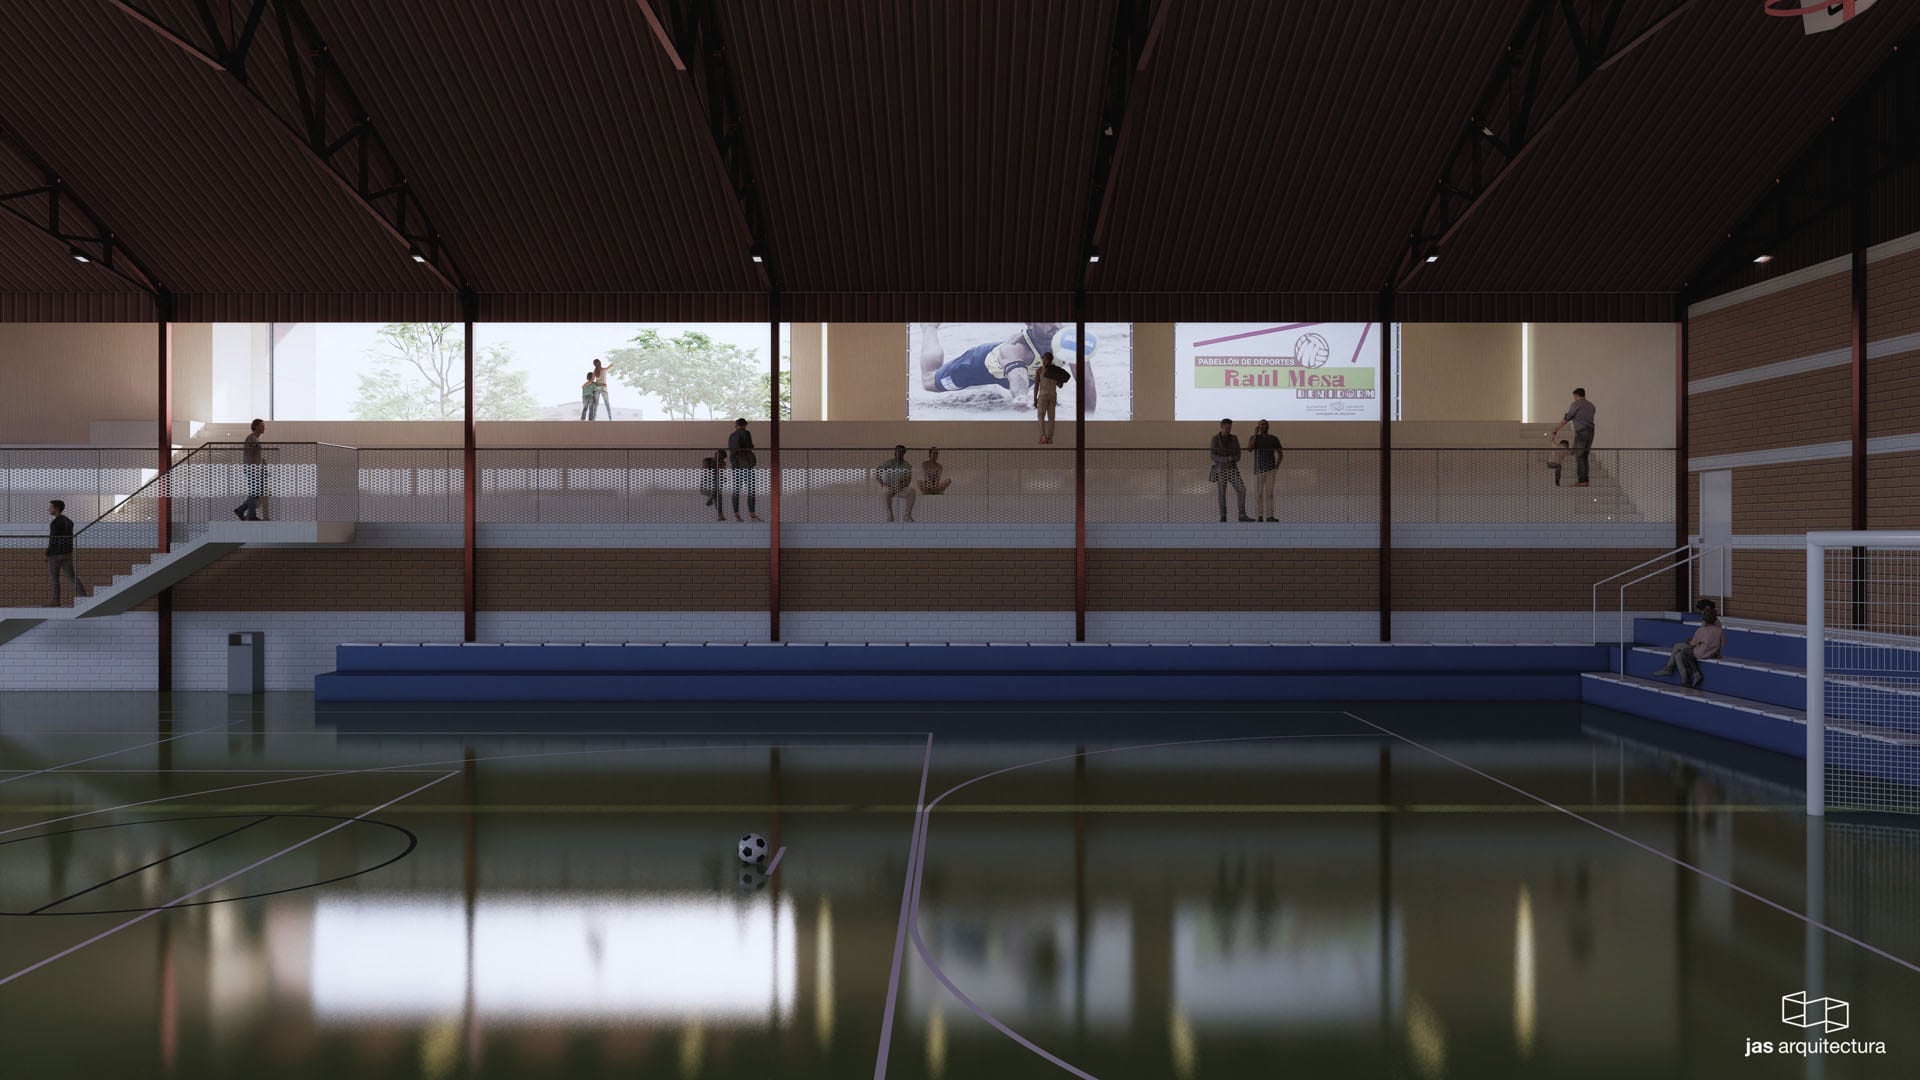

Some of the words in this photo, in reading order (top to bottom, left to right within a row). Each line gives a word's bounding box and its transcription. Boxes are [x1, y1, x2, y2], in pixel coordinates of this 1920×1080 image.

[1198, 358, 1240, 366] PABELLÓN
[1224, 369, 1278, 387] Raúl
[1288, 369, 1345, 387] Mesa
[1296, 389, 1375, 399] BENIDORM
